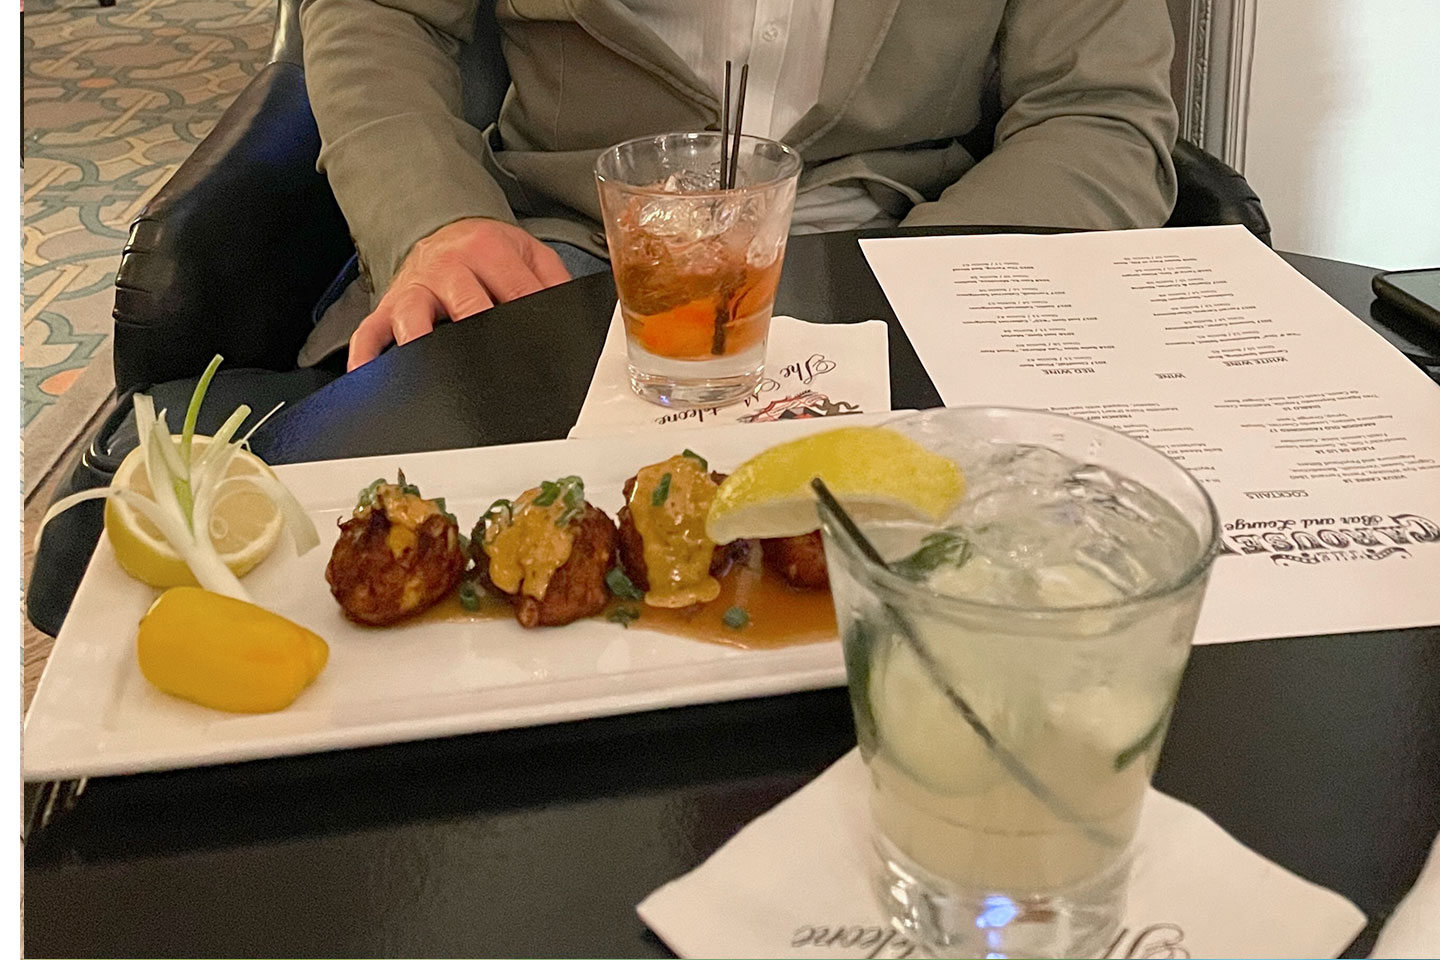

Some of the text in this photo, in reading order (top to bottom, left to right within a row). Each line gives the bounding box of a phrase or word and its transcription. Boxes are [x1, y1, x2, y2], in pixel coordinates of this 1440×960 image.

[1221, 356, 1288, 367] WHITE WINE
[780, 352, 836, 385] The
[1041, 368, 1074, 376] WINE
[1154, 372, 1186, 380] WINE
[1243, 489, 1309, 499] COCKTAILS
[1224, 515, 1382, 531] Bar and Lounge
